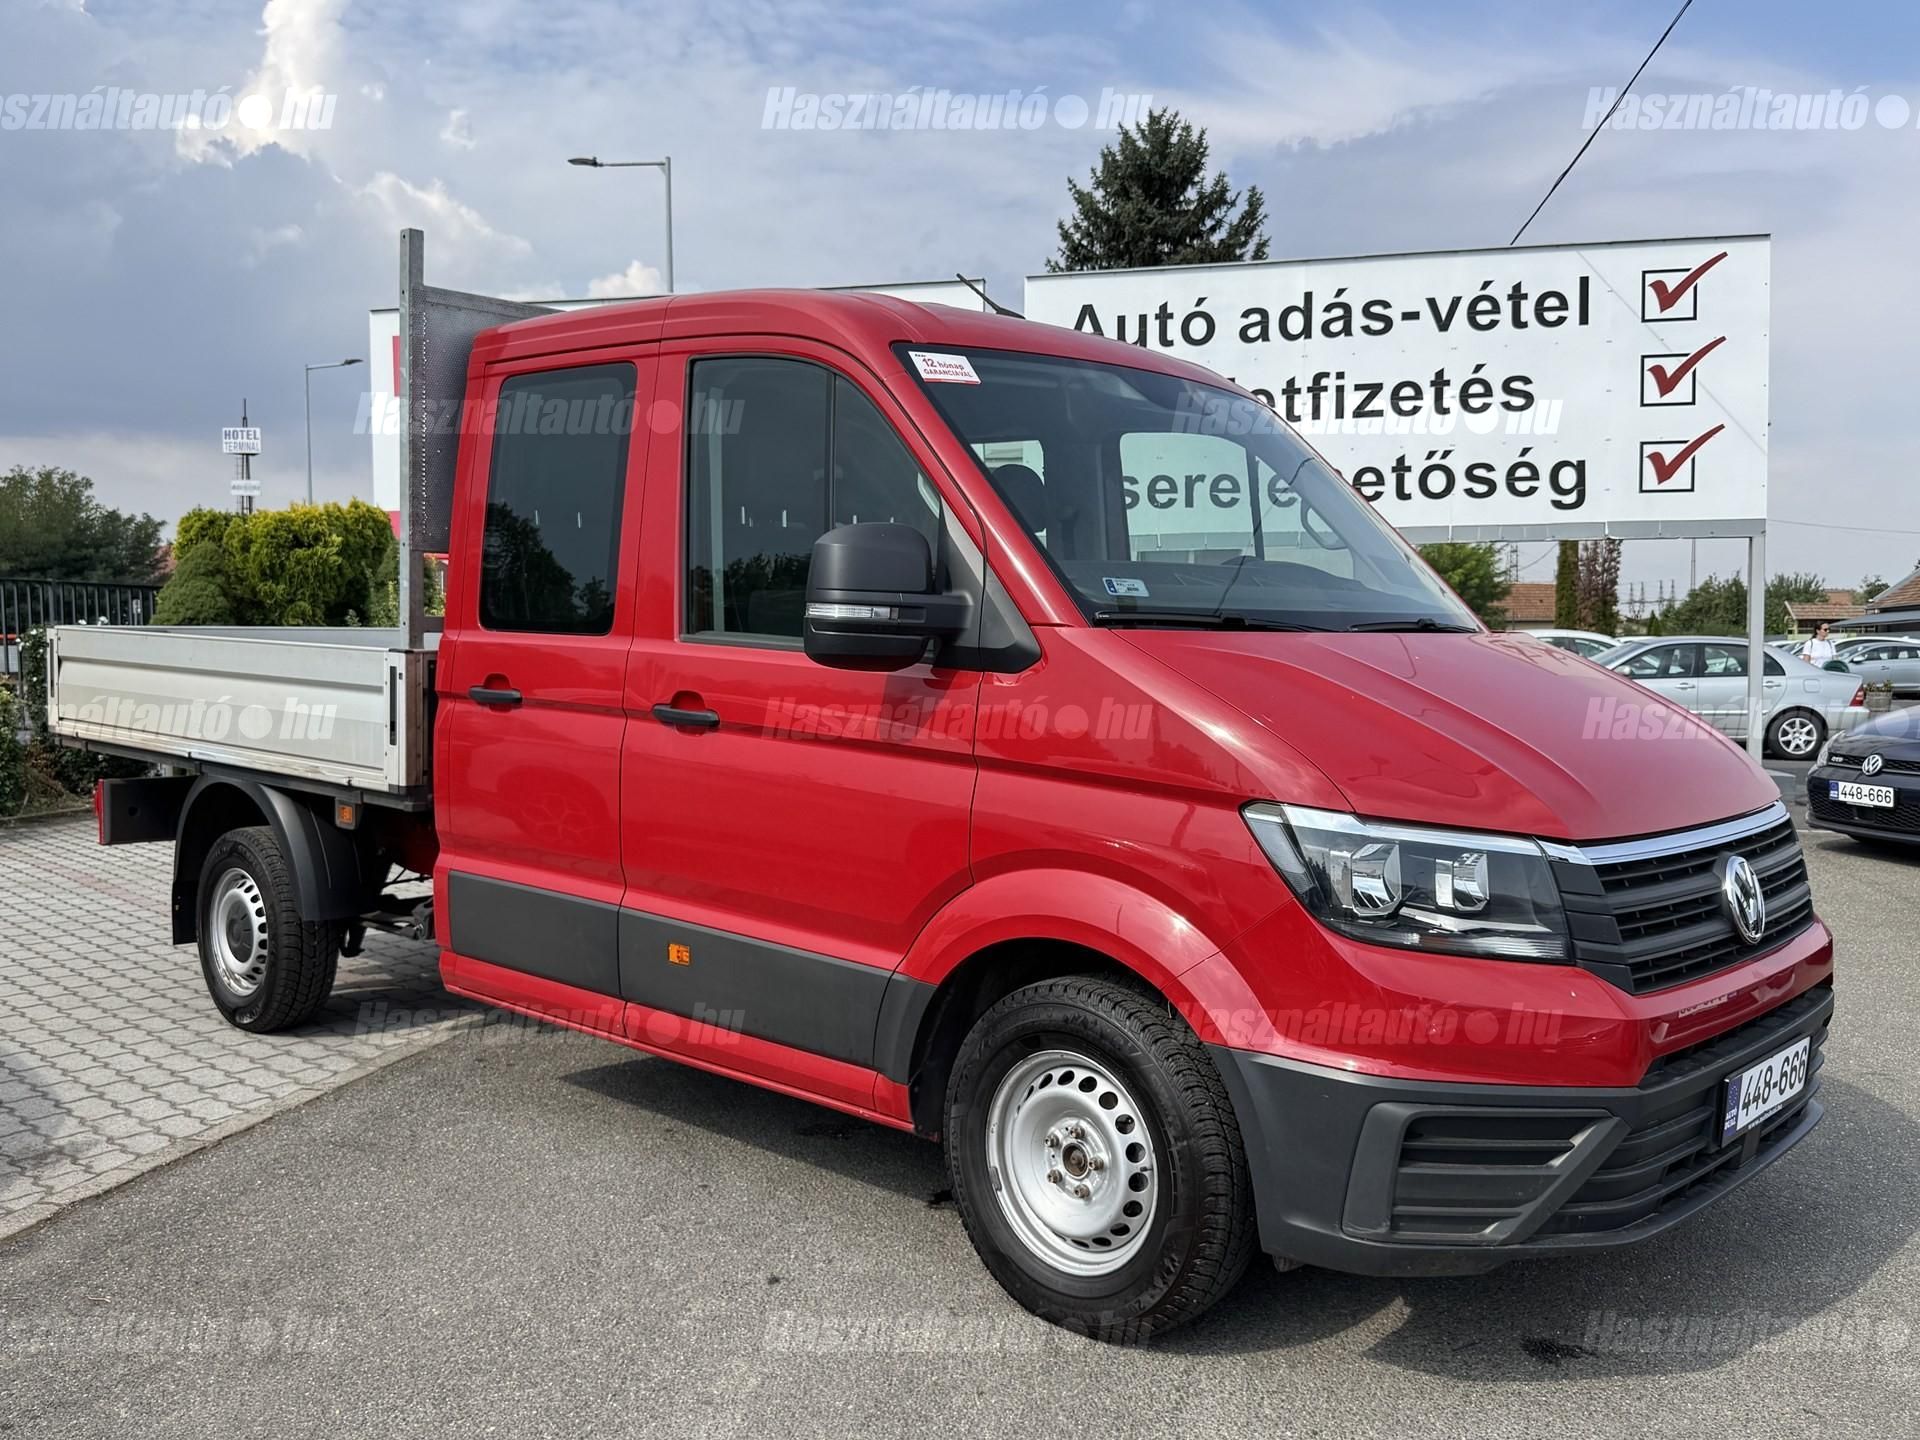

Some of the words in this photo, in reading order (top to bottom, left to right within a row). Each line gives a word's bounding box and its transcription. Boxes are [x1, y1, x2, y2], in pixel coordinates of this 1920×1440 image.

[1073, 297, 1216, 347] Autó
[1238, 275, 1591, 344] adás-vétel
[922, 358, 937, 368] 12
[1229, 363, 1536, 423] etfizetés
[224, 429, 260, 441] HOTEL
[224, 441, 260, 452] TERMINAL
[1840, 784, 1892, 804] 448-666
[1741, 1045, 1808, 1117] 448-666
